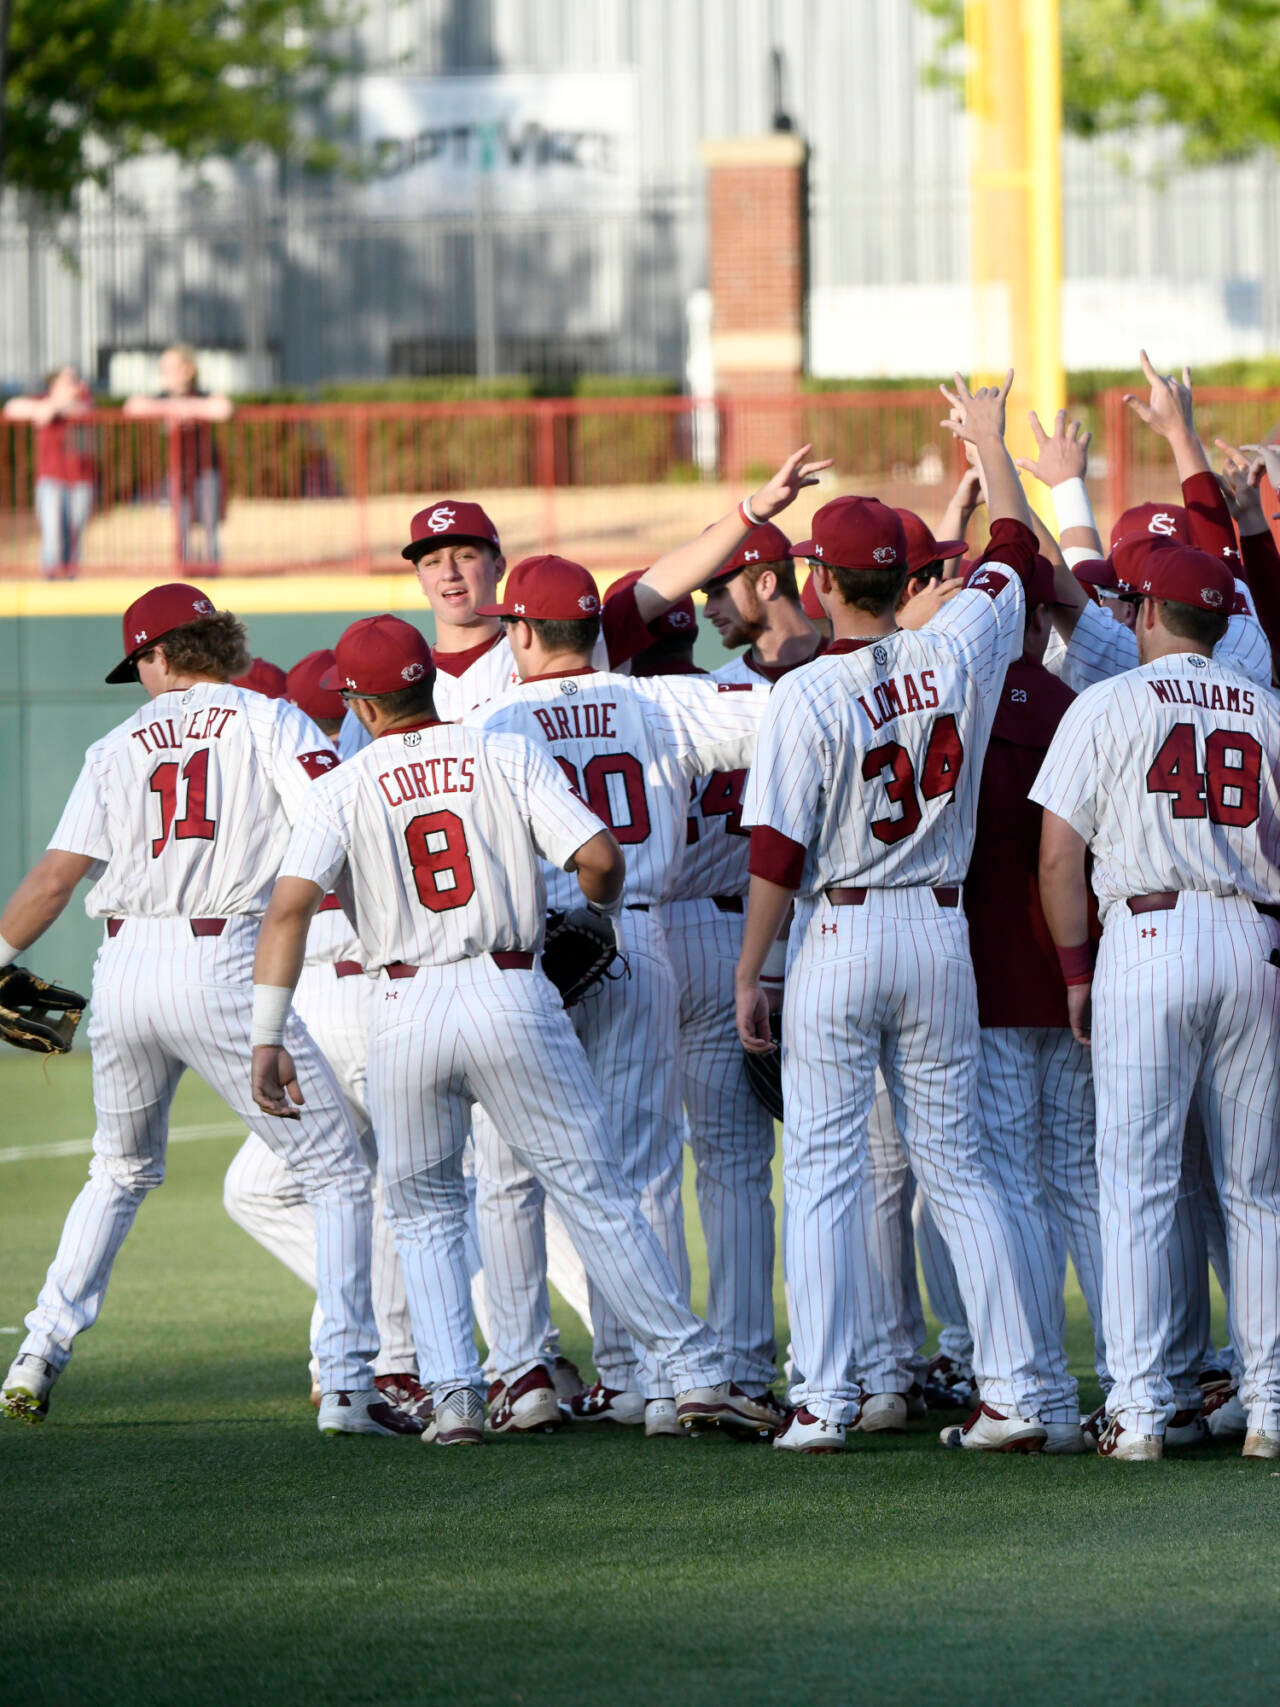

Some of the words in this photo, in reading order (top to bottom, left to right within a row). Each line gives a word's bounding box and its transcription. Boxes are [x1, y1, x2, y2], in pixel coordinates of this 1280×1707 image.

[533, 702, 617, 742] BRIDE
[857, 669, 940, 731] LOMAS
[1011, 689, 1027, 703] 23
[1147, 679, 1255, 716] WILLIAMS
[131, 707, 237, 755] TOLERT
[150, 747, 216, 859] 11
[378, 757, 475, 807] CORTES
[861, 713, 964, 846] 34
[1146, 722, 1263, 828] 48
[404, 809, 475, 914] 8
